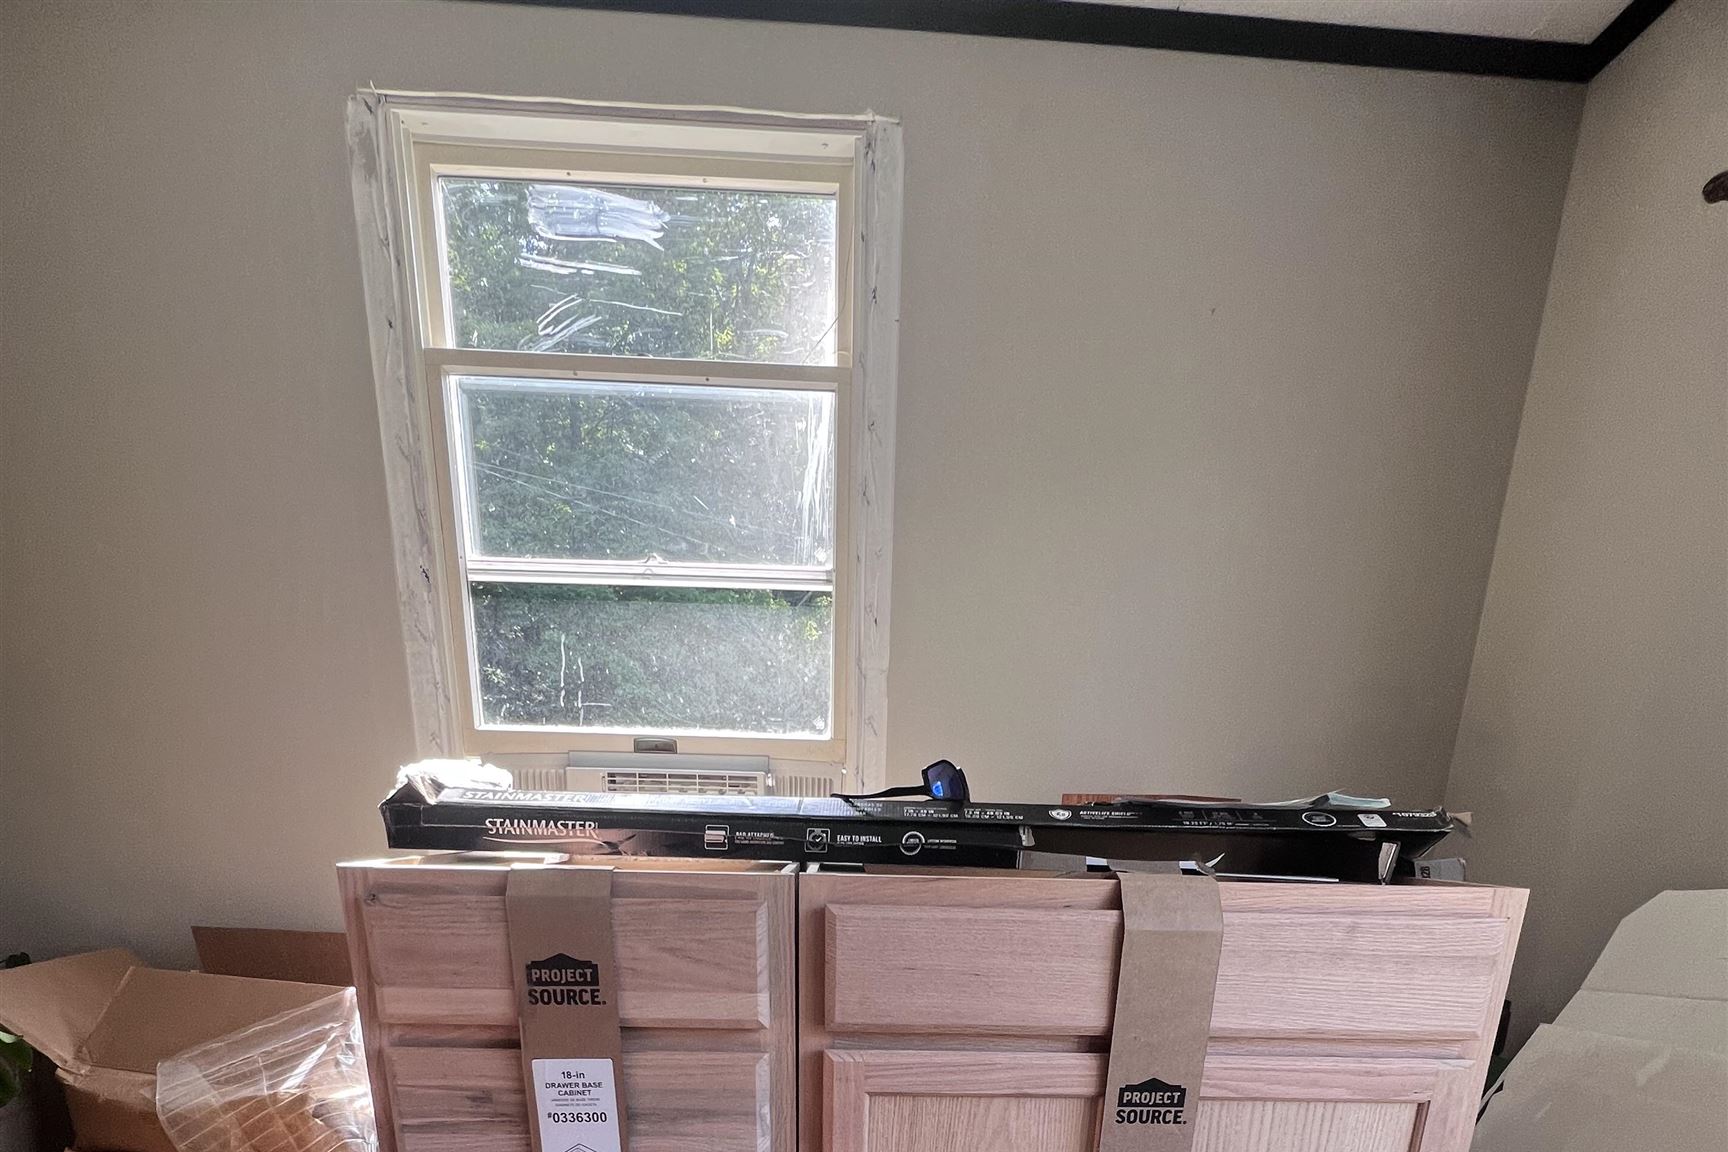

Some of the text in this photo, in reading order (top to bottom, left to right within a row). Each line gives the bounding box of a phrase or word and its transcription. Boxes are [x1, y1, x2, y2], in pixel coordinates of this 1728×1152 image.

[485, 818, 598, 839] STAINMASTER
[531, 968, 592, 984] PROJECT
[527, 988, 607, 1006] SOURCE.
[561, 1070, 586, 1080] 18-in
[1123, 1092, 1181, 1105] PROJECT
[547, 1112, 607, 1123] #0336300
[1115, 1109, 1187, 1124] SOURCE.
